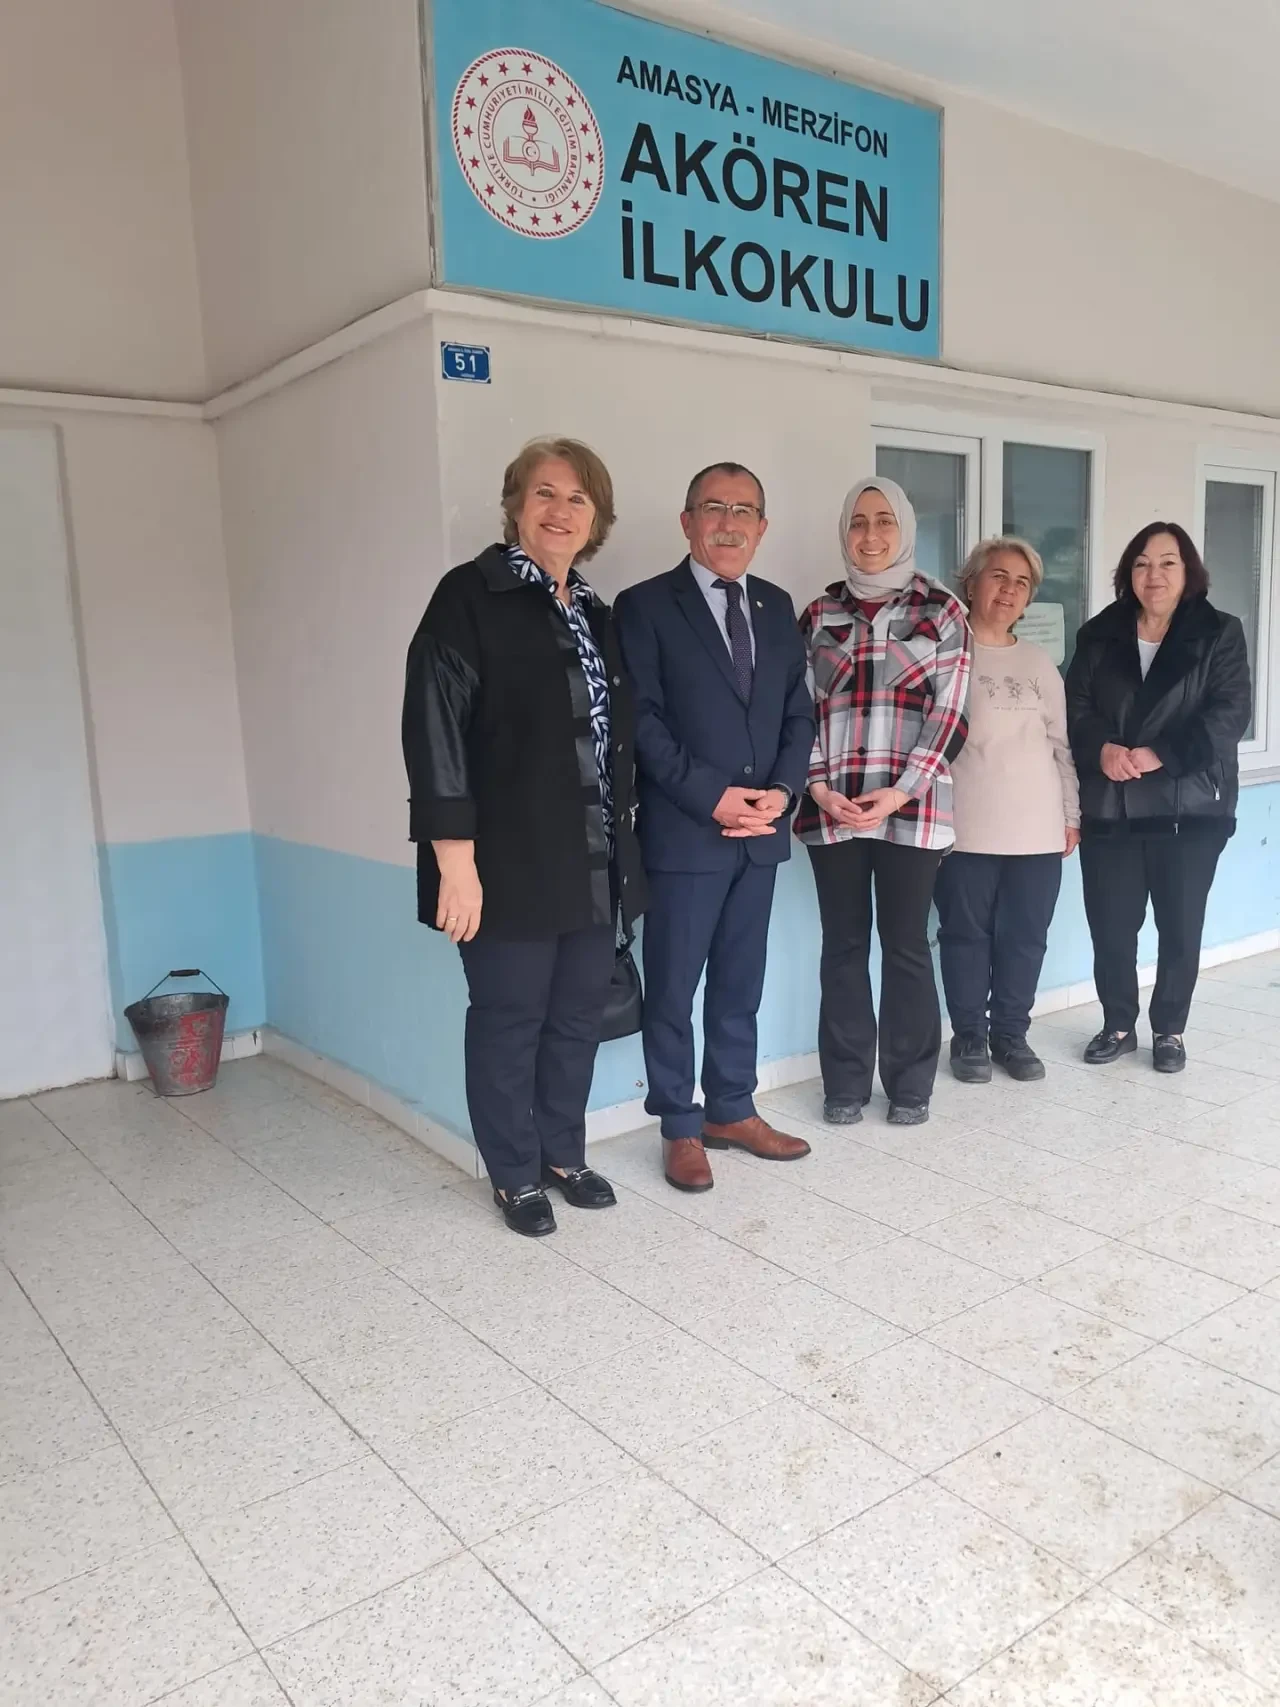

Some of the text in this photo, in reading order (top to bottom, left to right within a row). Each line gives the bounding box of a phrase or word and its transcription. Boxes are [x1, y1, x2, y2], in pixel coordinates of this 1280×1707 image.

[482, 83, 522, 149] CUMHURİYETİ
[554, 106, 577, 150] EĞİTİM
[616, 55, 888, 158] AMASYA - MERZİFON
[487, 155, 524, 199] TÜRKİYE
[545, 154, 578, 203] BAKANLIĞI
[620, 122, 888, 242] AKÖREN
[621, 198, 930, 332] İLKOKULU
[454, 352, 476, 373] 51
